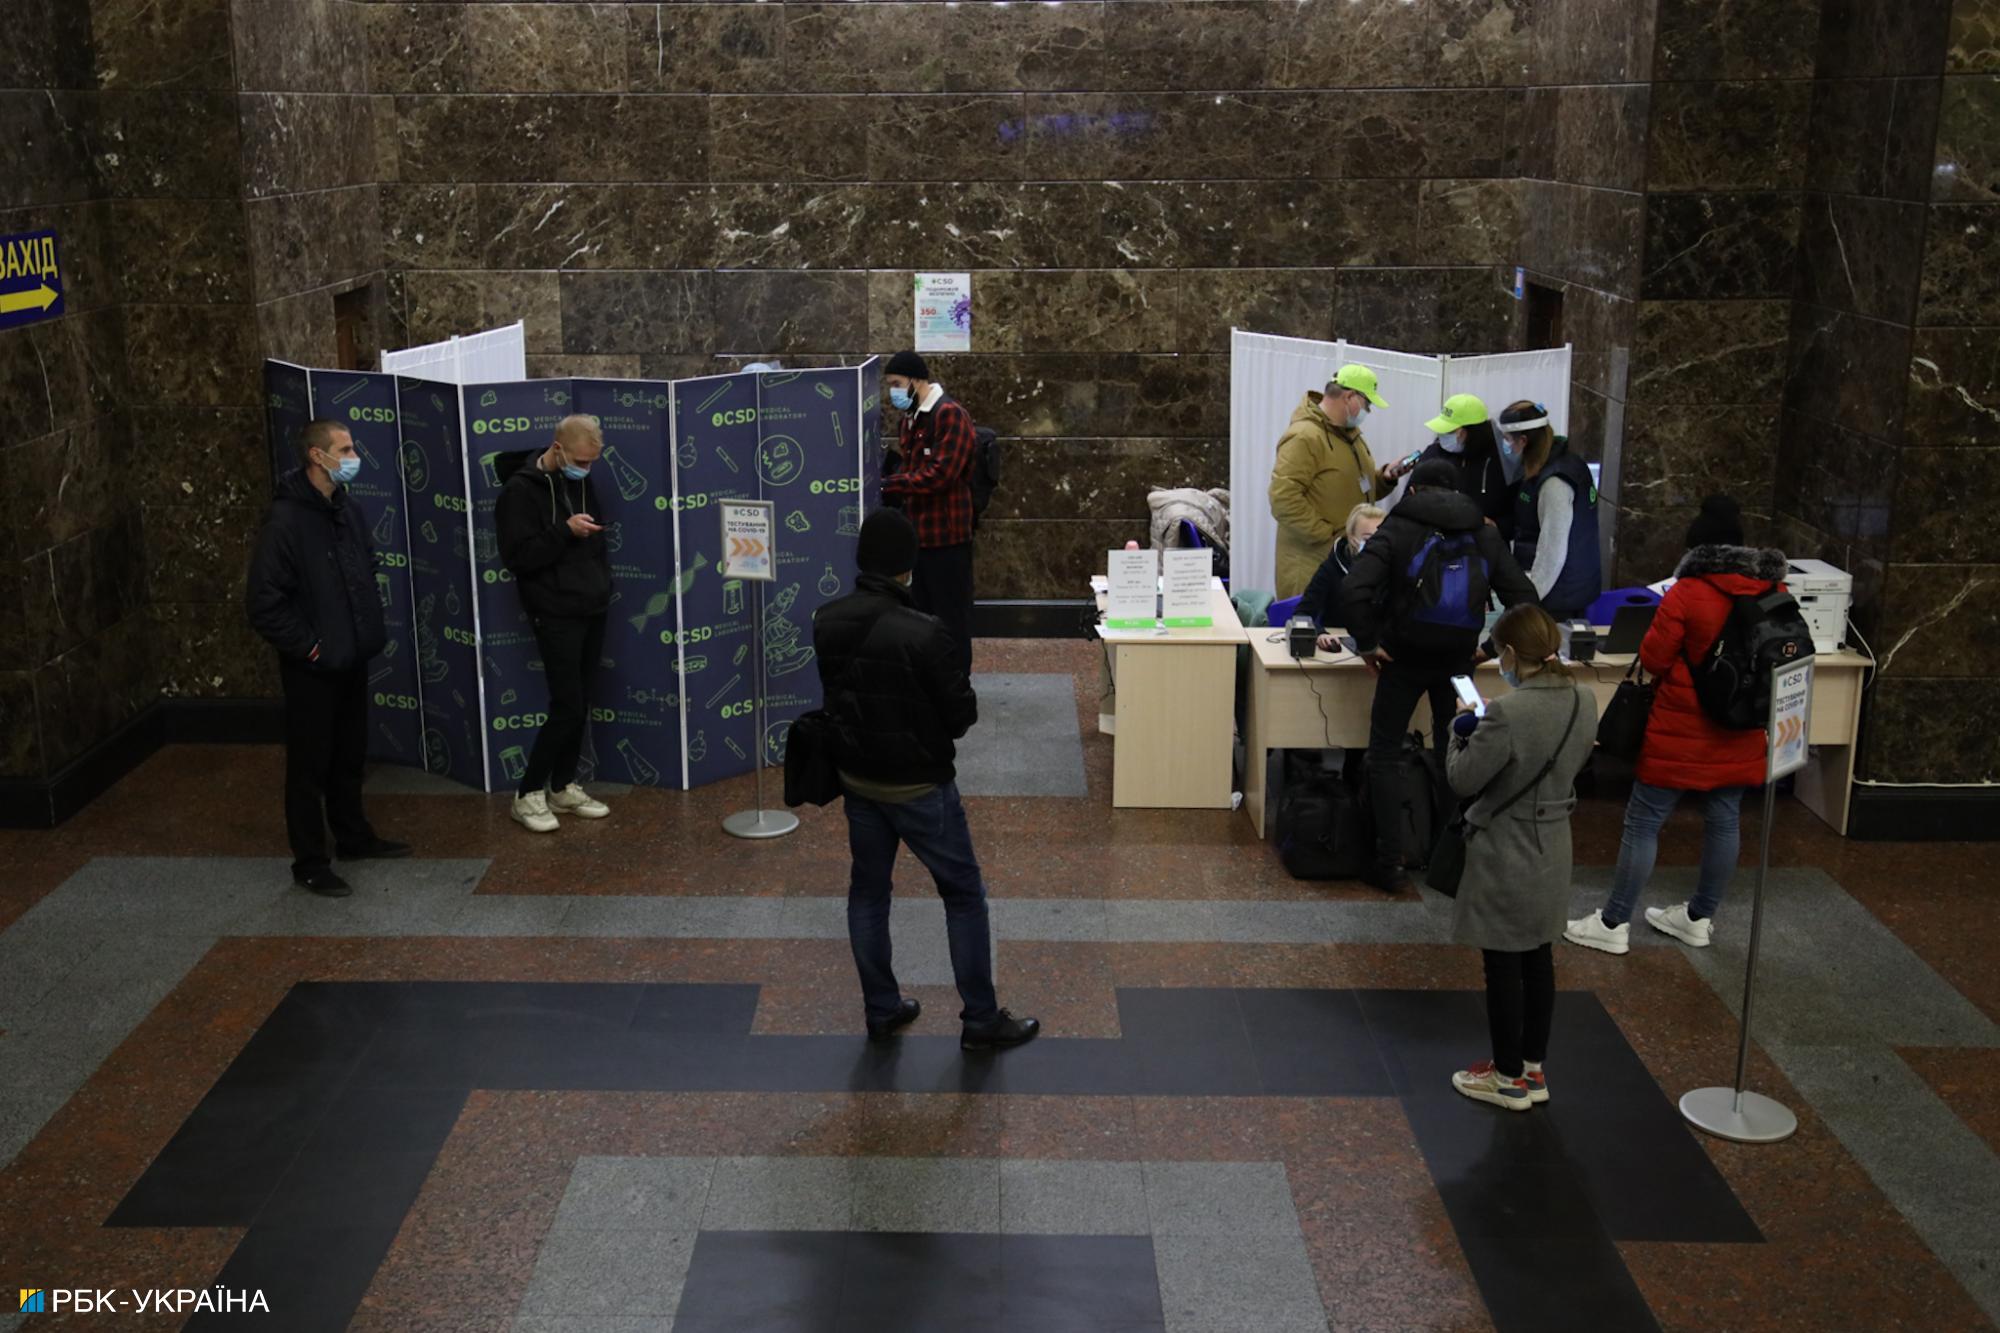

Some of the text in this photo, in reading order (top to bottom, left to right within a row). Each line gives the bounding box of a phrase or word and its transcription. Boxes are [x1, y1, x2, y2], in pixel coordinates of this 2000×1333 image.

[488, 417, 531, 433] CSD
[507, 712, 549, 730] CSD
[592, 707, 615, 722] SD
